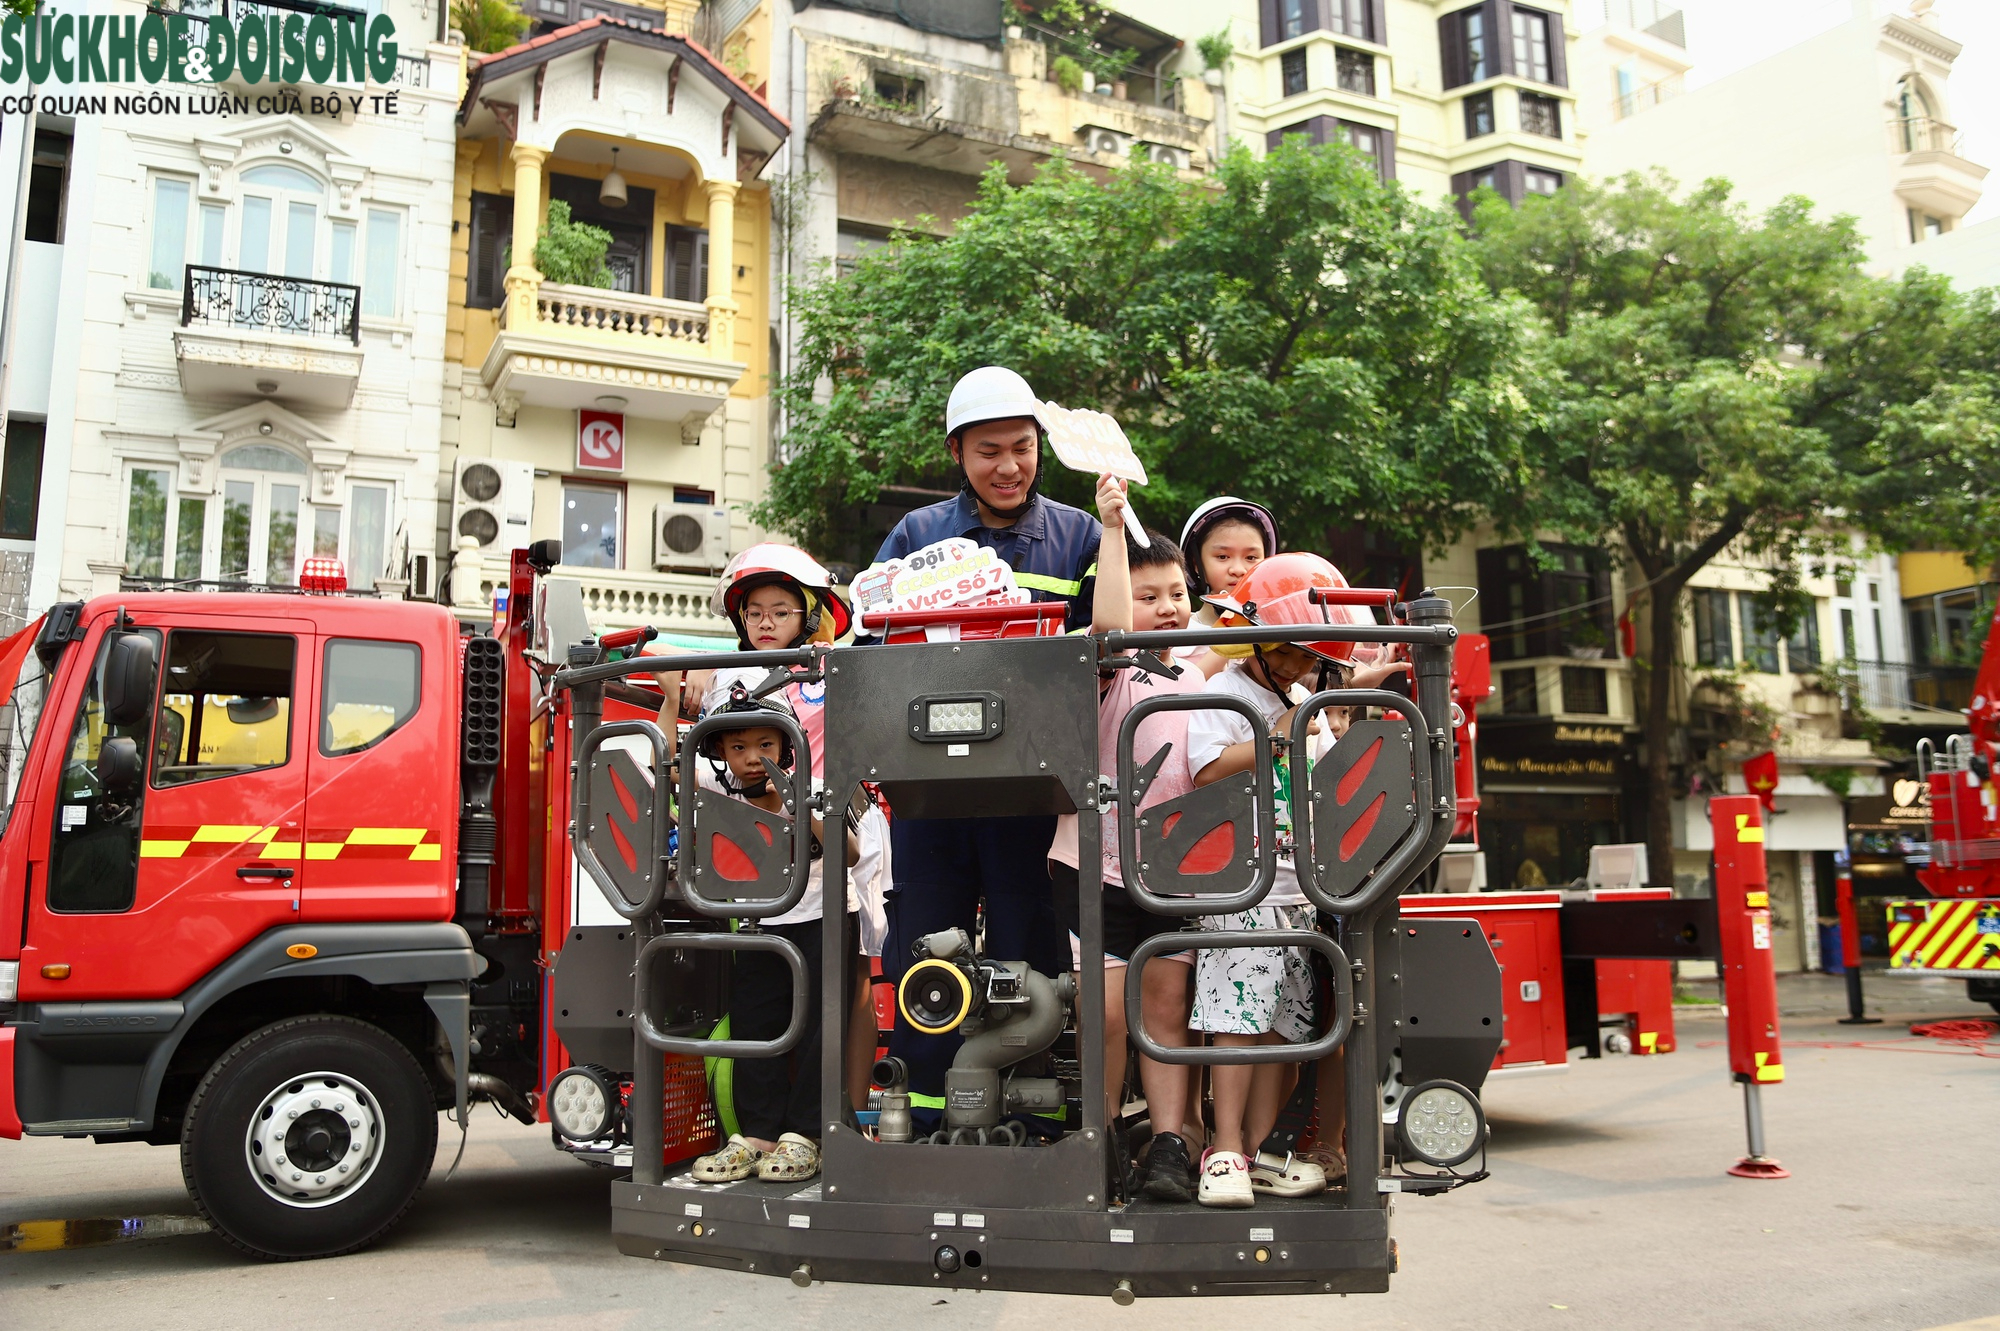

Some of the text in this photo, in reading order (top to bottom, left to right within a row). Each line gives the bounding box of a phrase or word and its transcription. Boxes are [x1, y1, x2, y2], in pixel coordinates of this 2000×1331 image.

[593, 429, 619, 454] K
[909, 547, 945, 570] Đội
[896, 552, 991, 595] CC&CNCH
[957, 570, 986, 595] Số
[989, 567, 1003, 583] 7
[63, 1015, 158, 1027] DAEWOO
